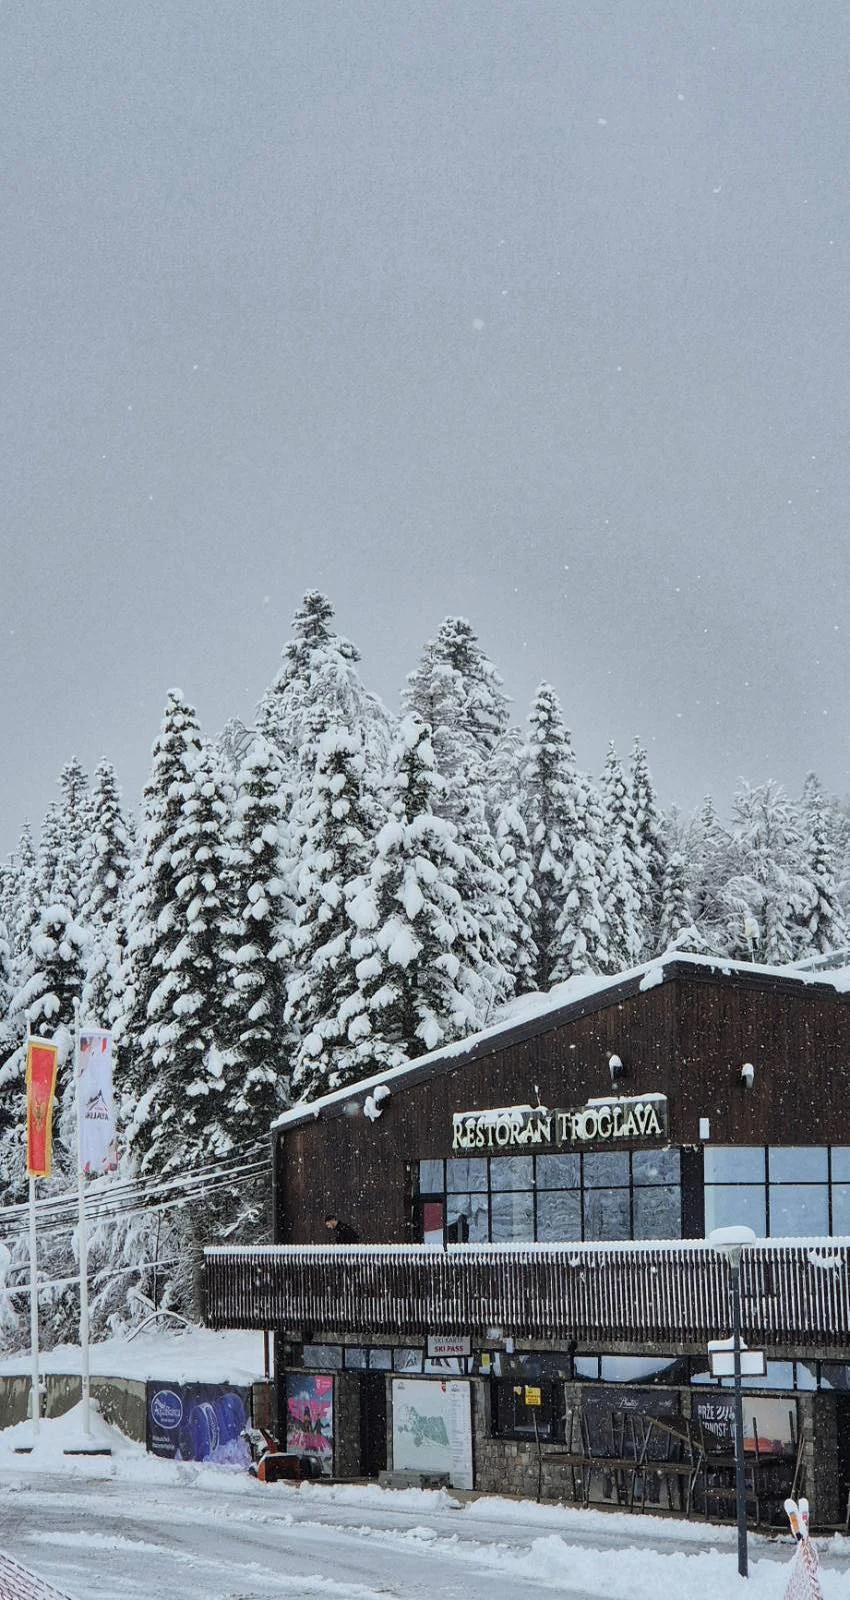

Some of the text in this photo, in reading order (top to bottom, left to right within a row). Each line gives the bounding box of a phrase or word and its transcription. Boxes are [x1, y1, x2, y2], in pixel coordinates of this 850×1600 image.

[452, 1104, 662, 1149] RESTORAN TROGLAVA
[434, 1345, 464, 1353] SKI PASS
